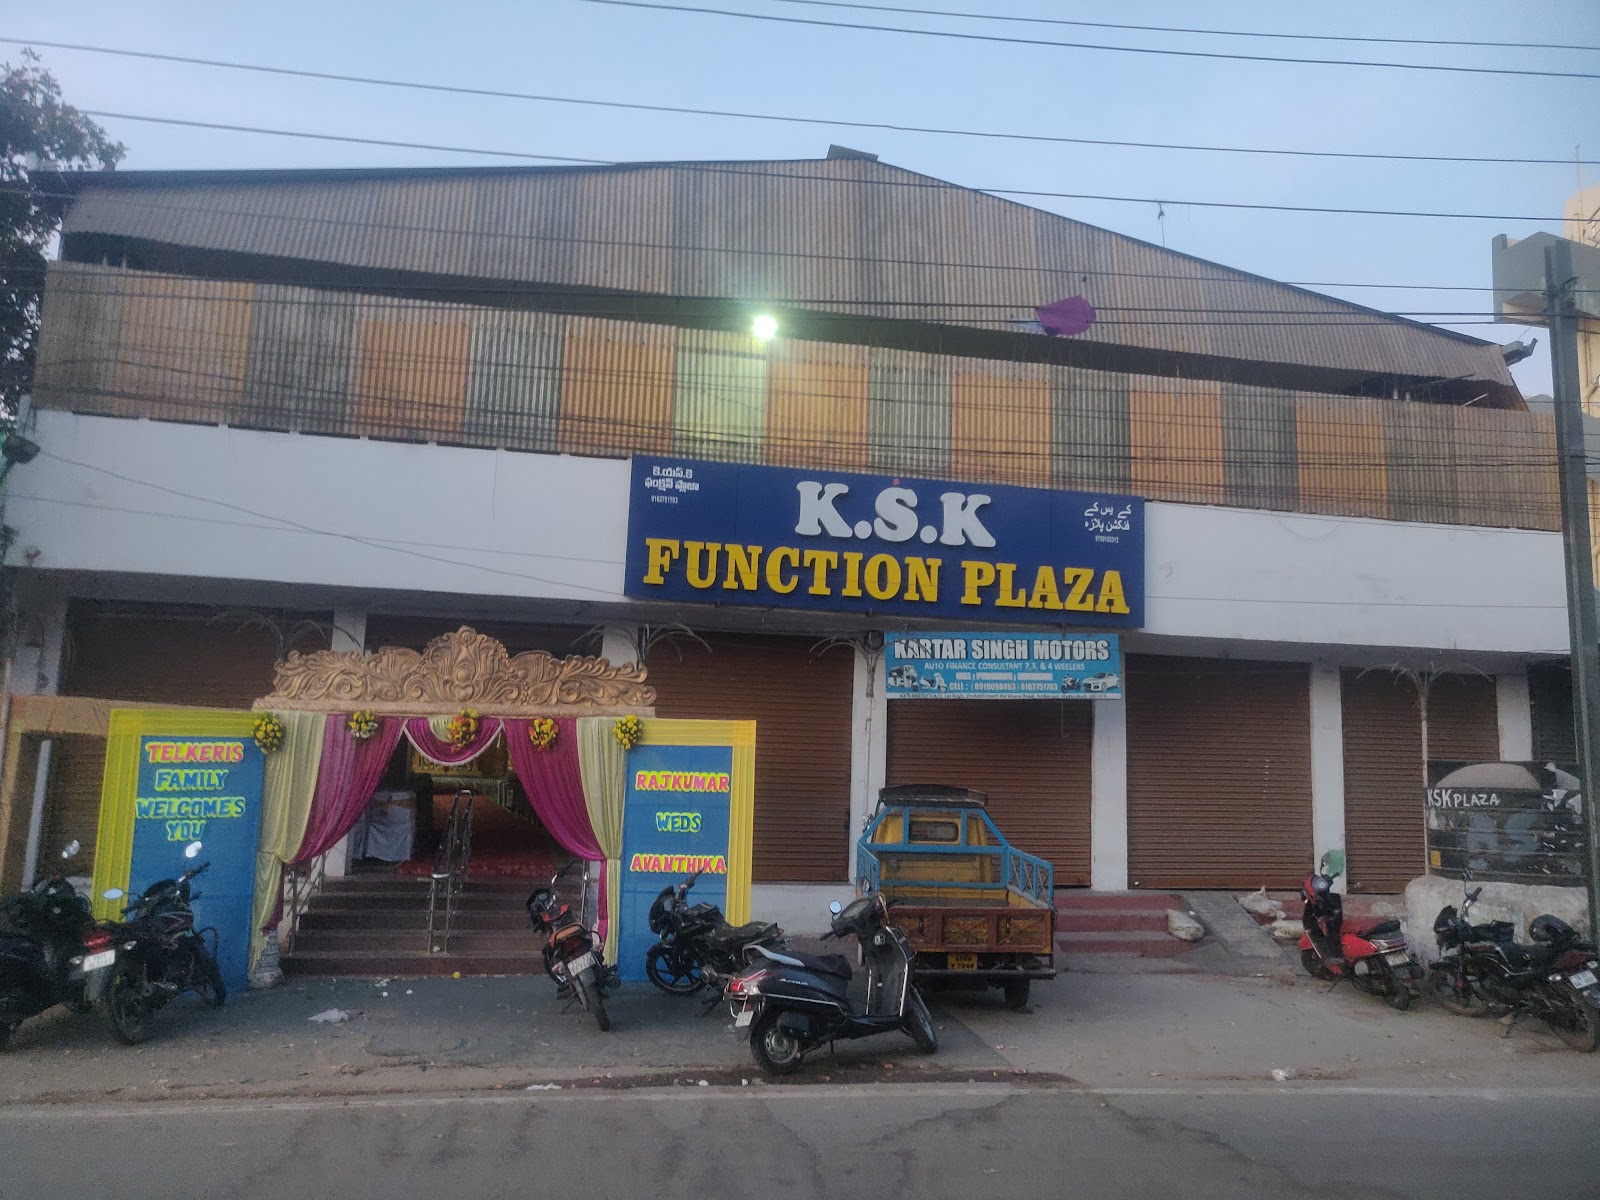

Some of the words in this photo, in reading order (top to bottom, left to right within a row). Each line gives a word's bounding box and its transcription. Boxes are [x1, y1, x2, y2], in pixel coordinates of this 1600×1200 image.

[795, 480, 996, 548] K.S.K
[643, 537, 941, 603] FUNCTION
[960, 560, 1130, 615] PLAZA
[894, 638, 967, 659] KARTAR
[971, 639, 1029, 660] SINGH
[1033, 640, 1110, 661] MOTORS
[924, 662, 944, 670] AUTO
[946, 662, 976, 670] FINANCE
[978, 662, 1023, 671] CONSULTANT
[145, 741, 245, 764] TELKERIS
[154, 768, 229, 791] FAMILY
[635, 770, 730, 792] RAJKUMAR
[166, 819, 206, 842] YOU
[655, 812, 702, 832] WEDS
[630, 853, 728, 874] AVANTHIKA
